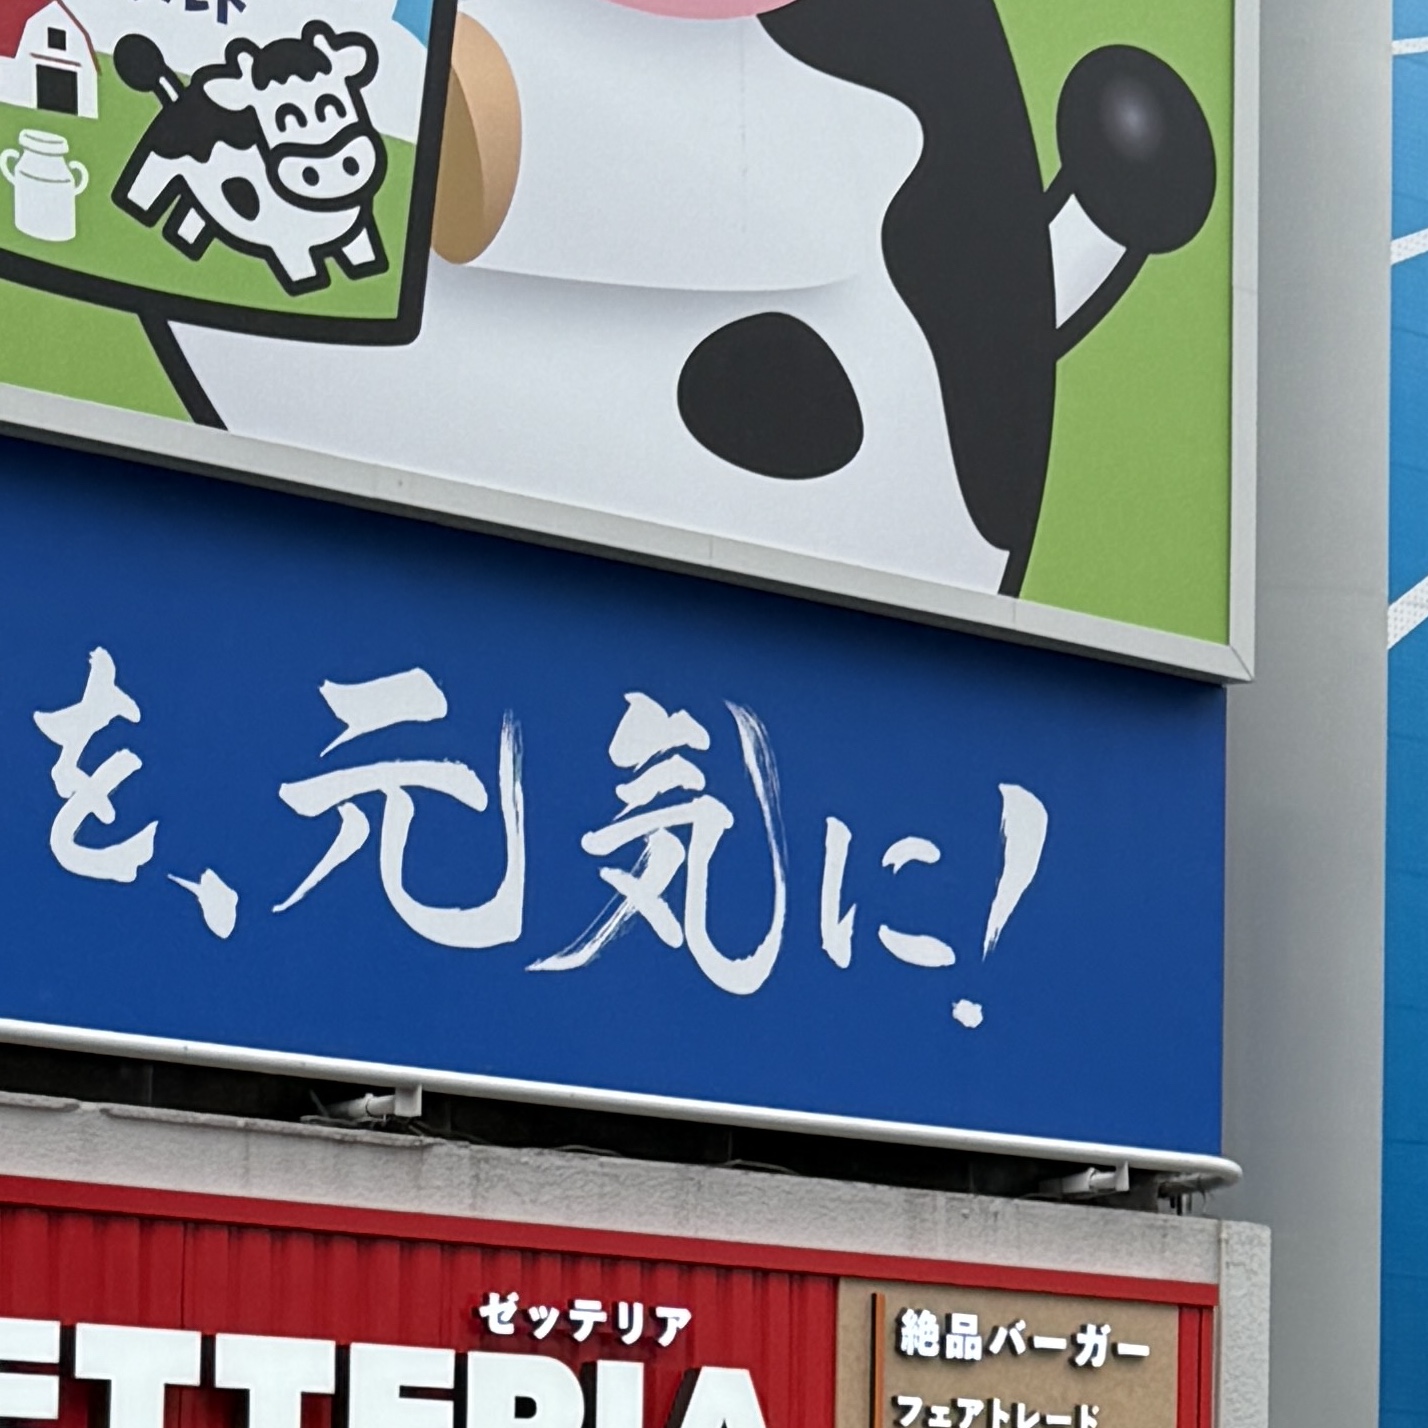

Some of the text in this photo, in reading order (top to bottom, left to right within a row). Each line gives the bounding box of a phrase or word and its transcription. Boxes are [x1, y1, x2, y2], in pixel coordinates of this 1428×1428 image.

[479, 1291, 691, 1347] ゼッテリア
[901, 1308, 1150, 1368] 絶品バーガー
